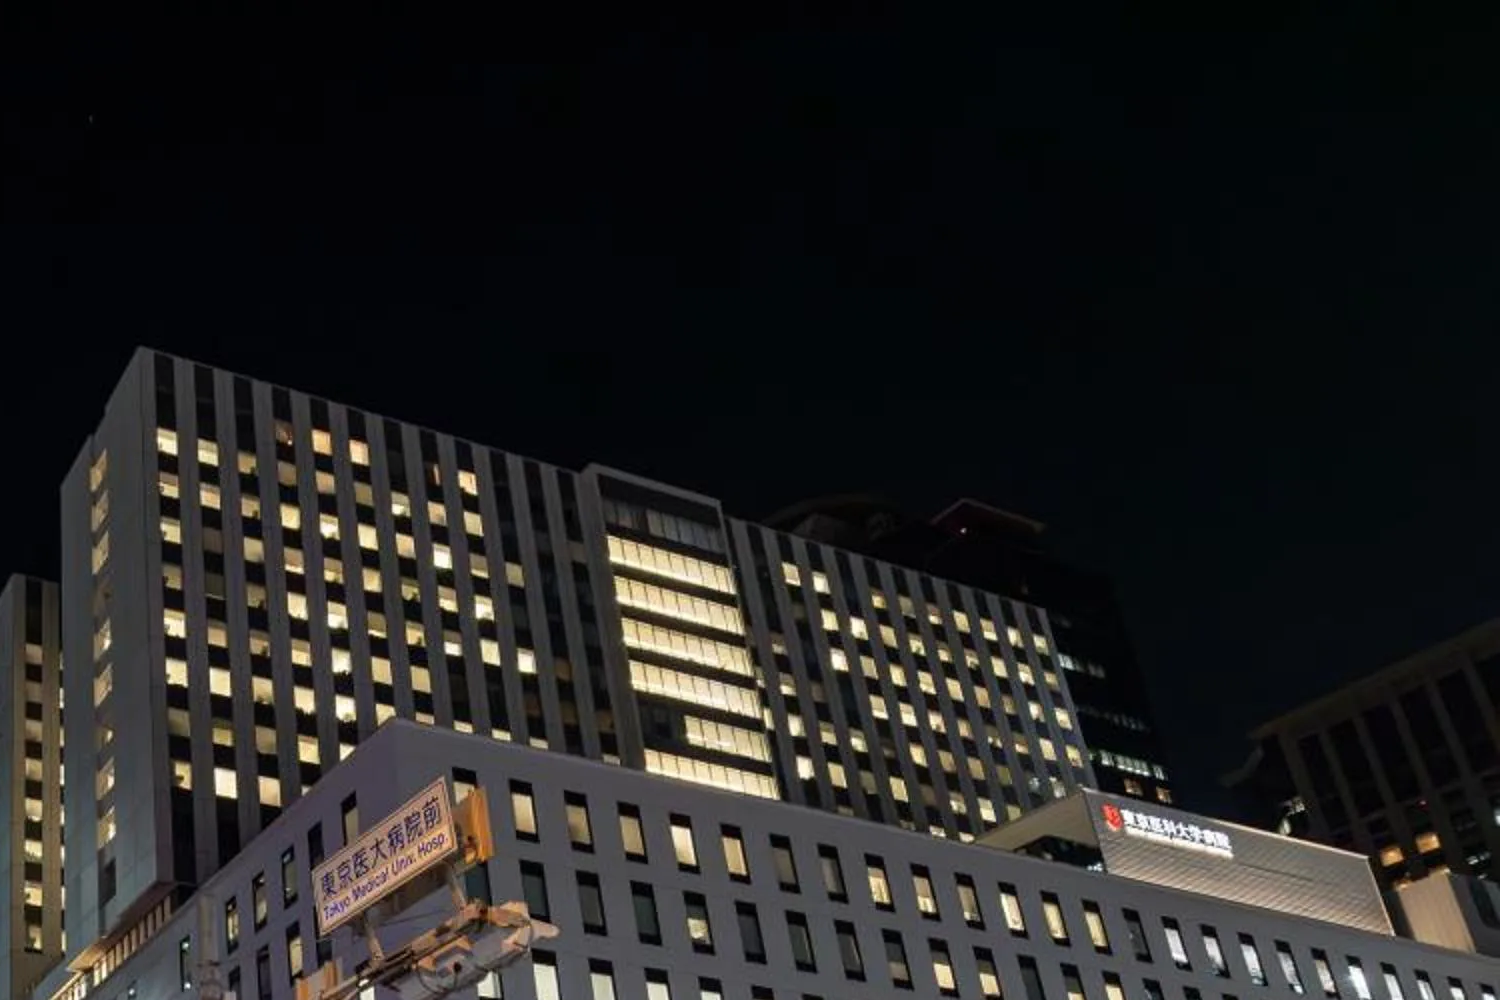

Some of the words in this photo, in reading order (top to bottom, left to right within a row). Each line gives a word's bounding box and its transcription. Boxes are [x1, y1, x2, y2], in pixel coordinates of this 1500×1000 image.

[321, 796, 441, 897] 東京医大病院前
[324, 896, 350, 920] Tokyo
[352, 868, 389, 900] Medical
[418, 833, 449, 857] Hosp.
